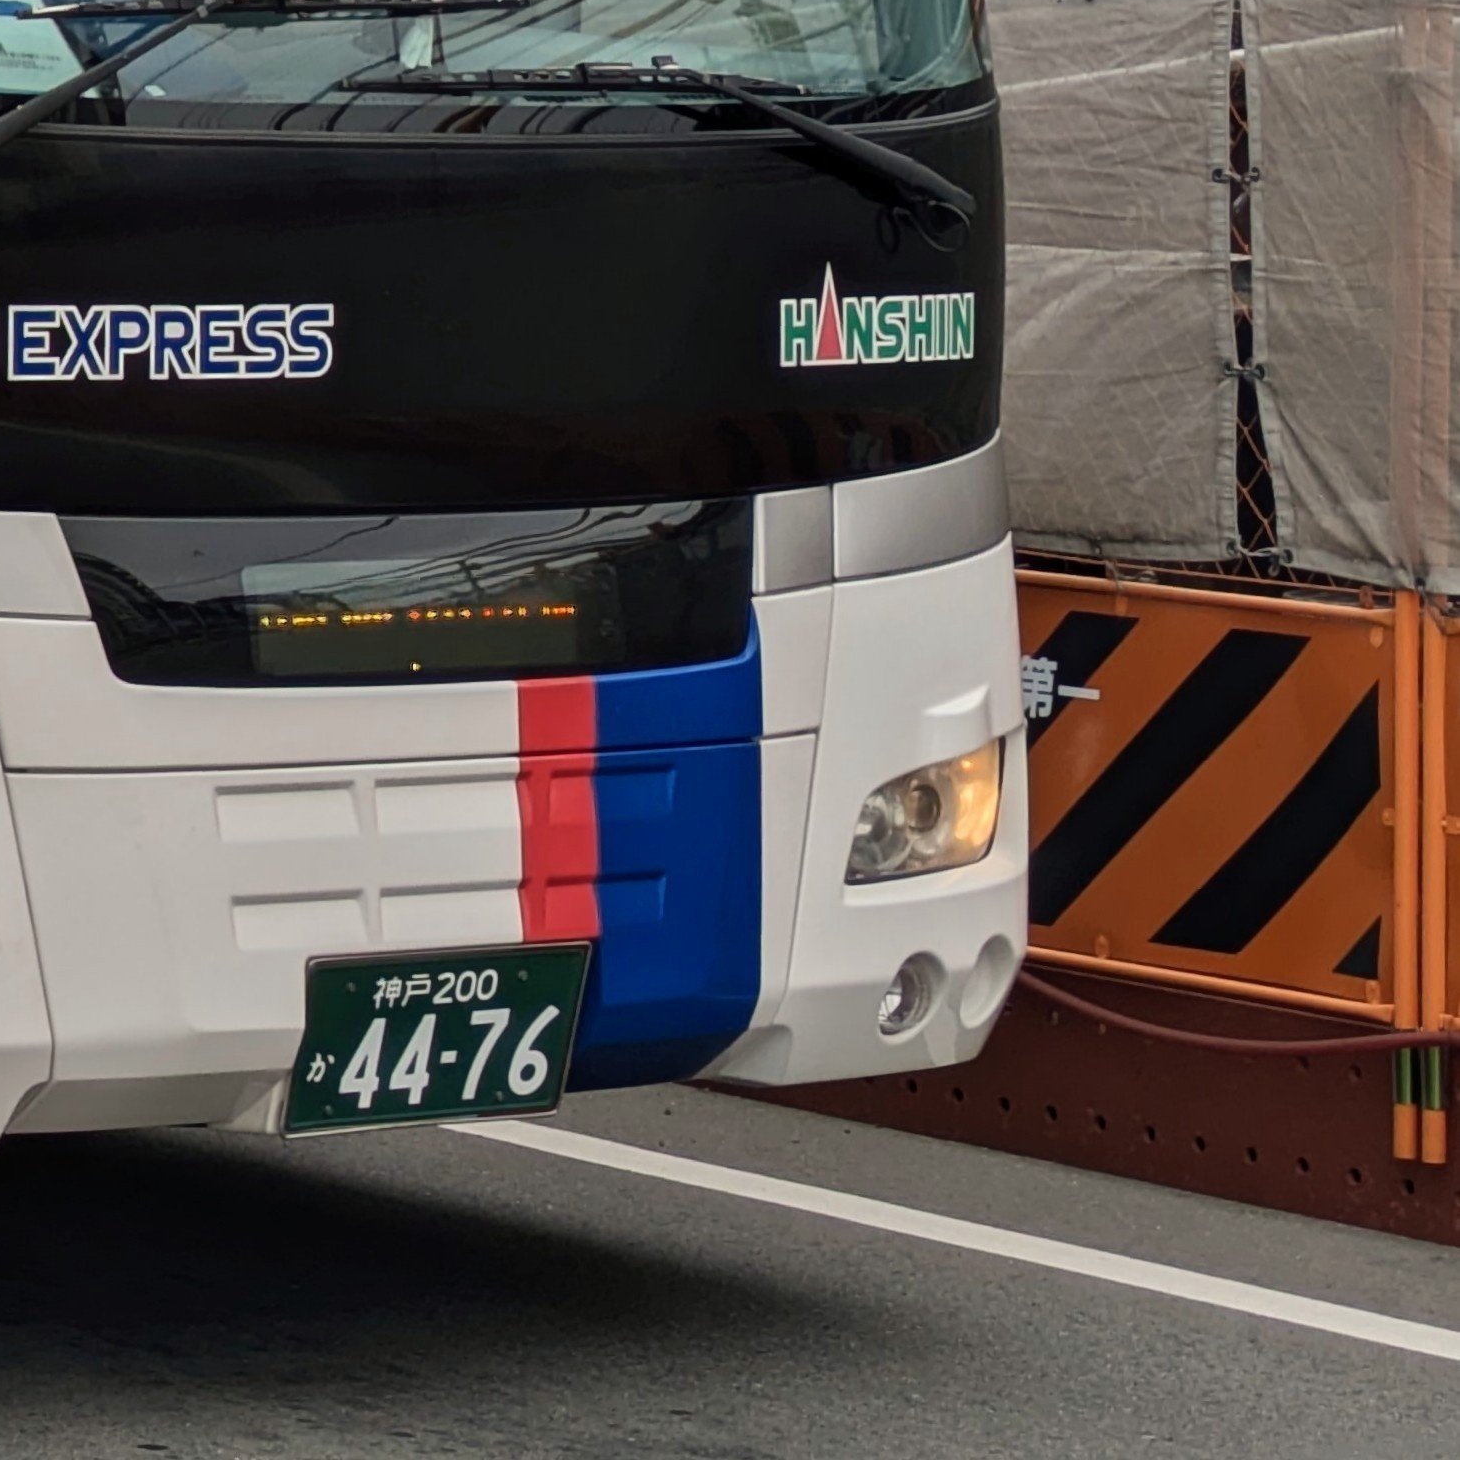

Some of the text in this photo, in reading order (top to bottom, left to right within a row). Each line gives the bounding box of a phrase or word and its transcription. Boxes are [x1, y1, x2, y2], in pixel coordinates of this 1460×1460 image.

[7, 303, 335, 382] EXPRESS
[779, 260, 975, 367] HANSHIN
[305, 1004, 560, 1109] か 44-76
